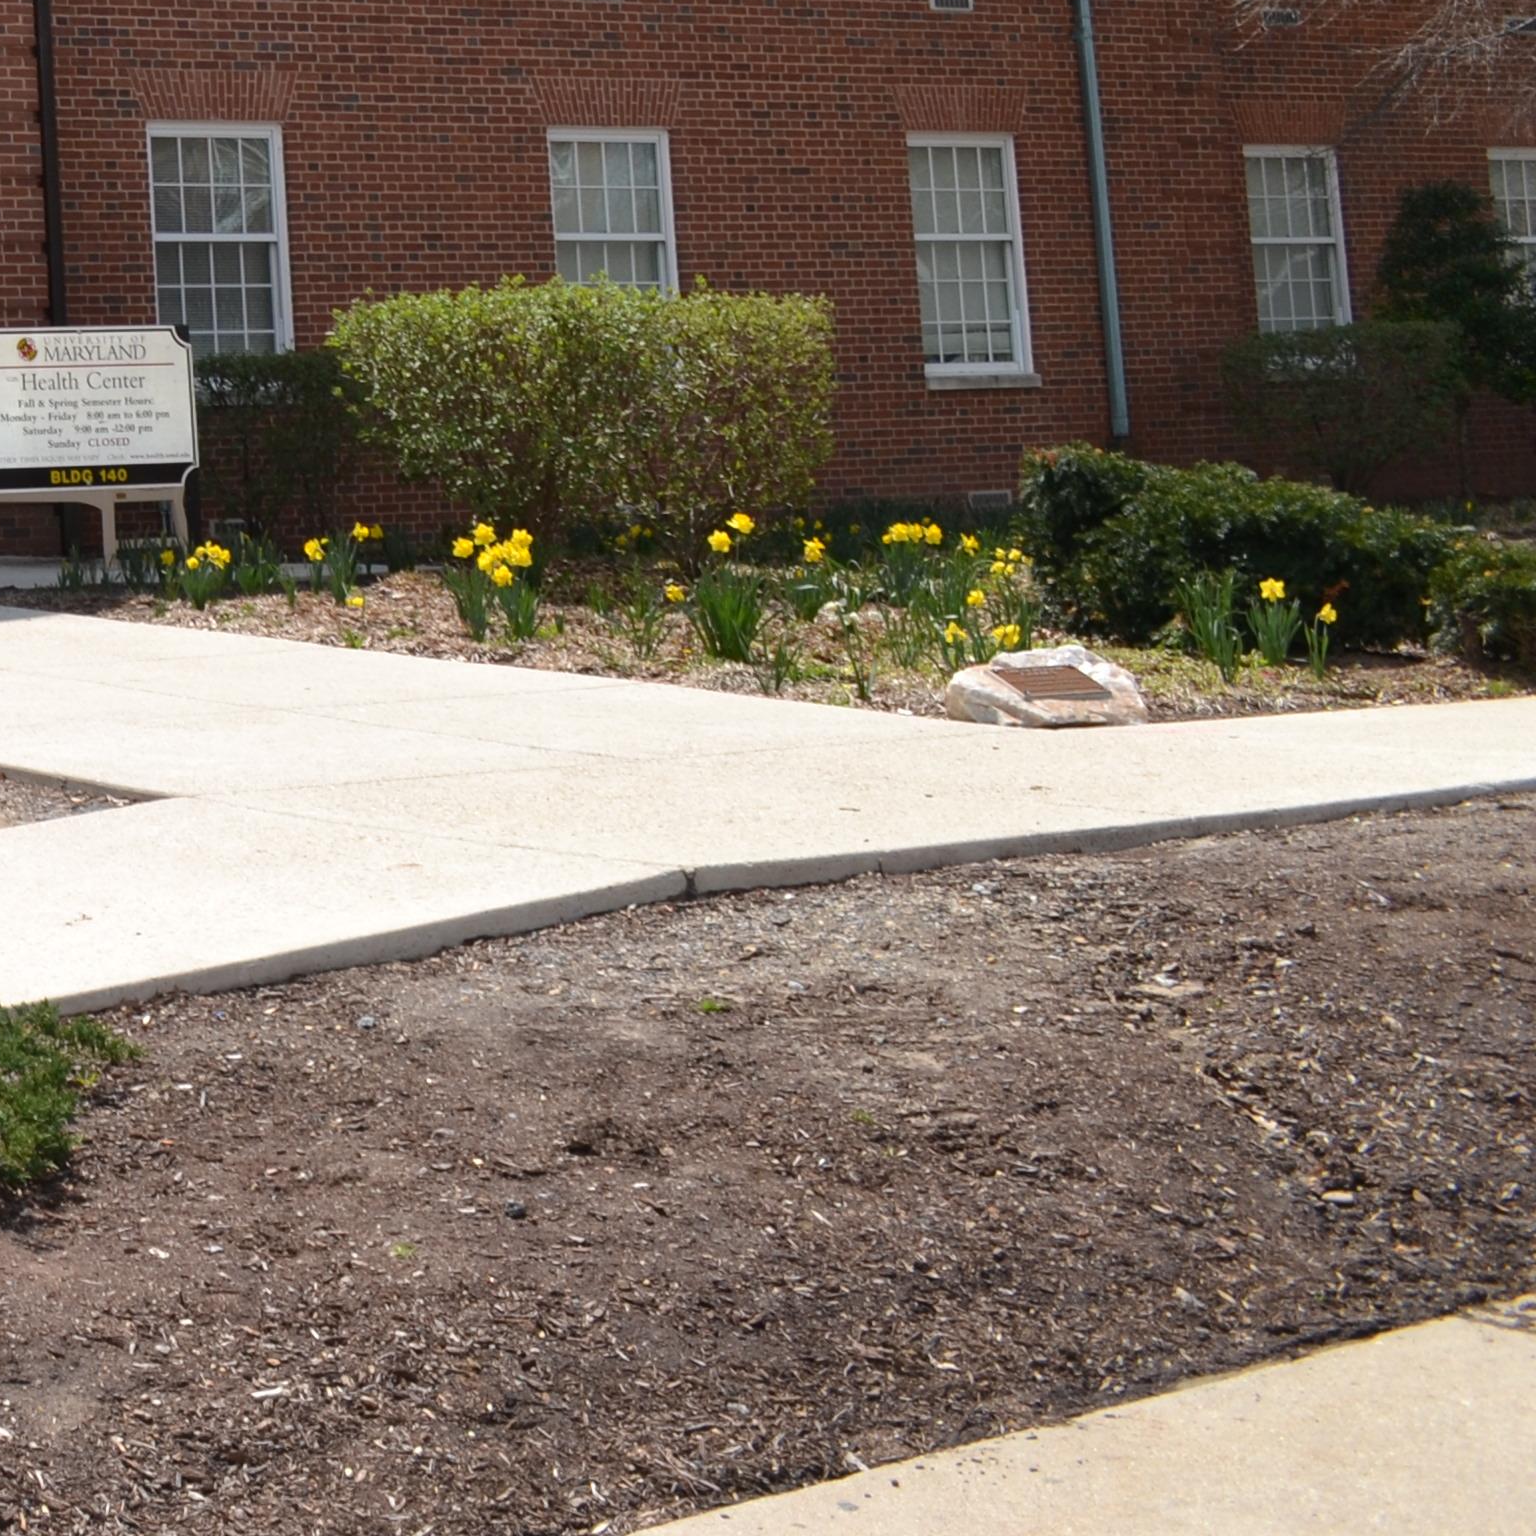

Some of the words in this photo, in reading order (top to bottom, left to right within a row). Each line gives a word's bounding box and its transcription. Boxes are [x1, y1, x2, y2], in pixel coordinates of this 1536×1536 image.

[43, 336, 124, 345] UNIVERSITY
[131, 335, 146, 344] OF
[43, 344, 147, 362] MARYLAND
[20, 371, 80, 391] Health
[86, 371, 146, 390] Center
[18, 399, 35, 408] Fall
[38, 399, 45, 408] &
[48, 398, 78, 410] Spring
[81, 397, 122, 407] Semester
[0, 413, 37, 424] Monday
[48, 412, 76, 423] Friday
[155, 411, 170, 420] pm
[23, 426, 62, 437] Saturday
[138, 425, 153, 434] pm
[47, 439, 80, 451] Sunday
[88, 437, 130, 447] CLOSED
[50, 469, 93, 484] BLDG
[100, 468, 128, 482] 140
